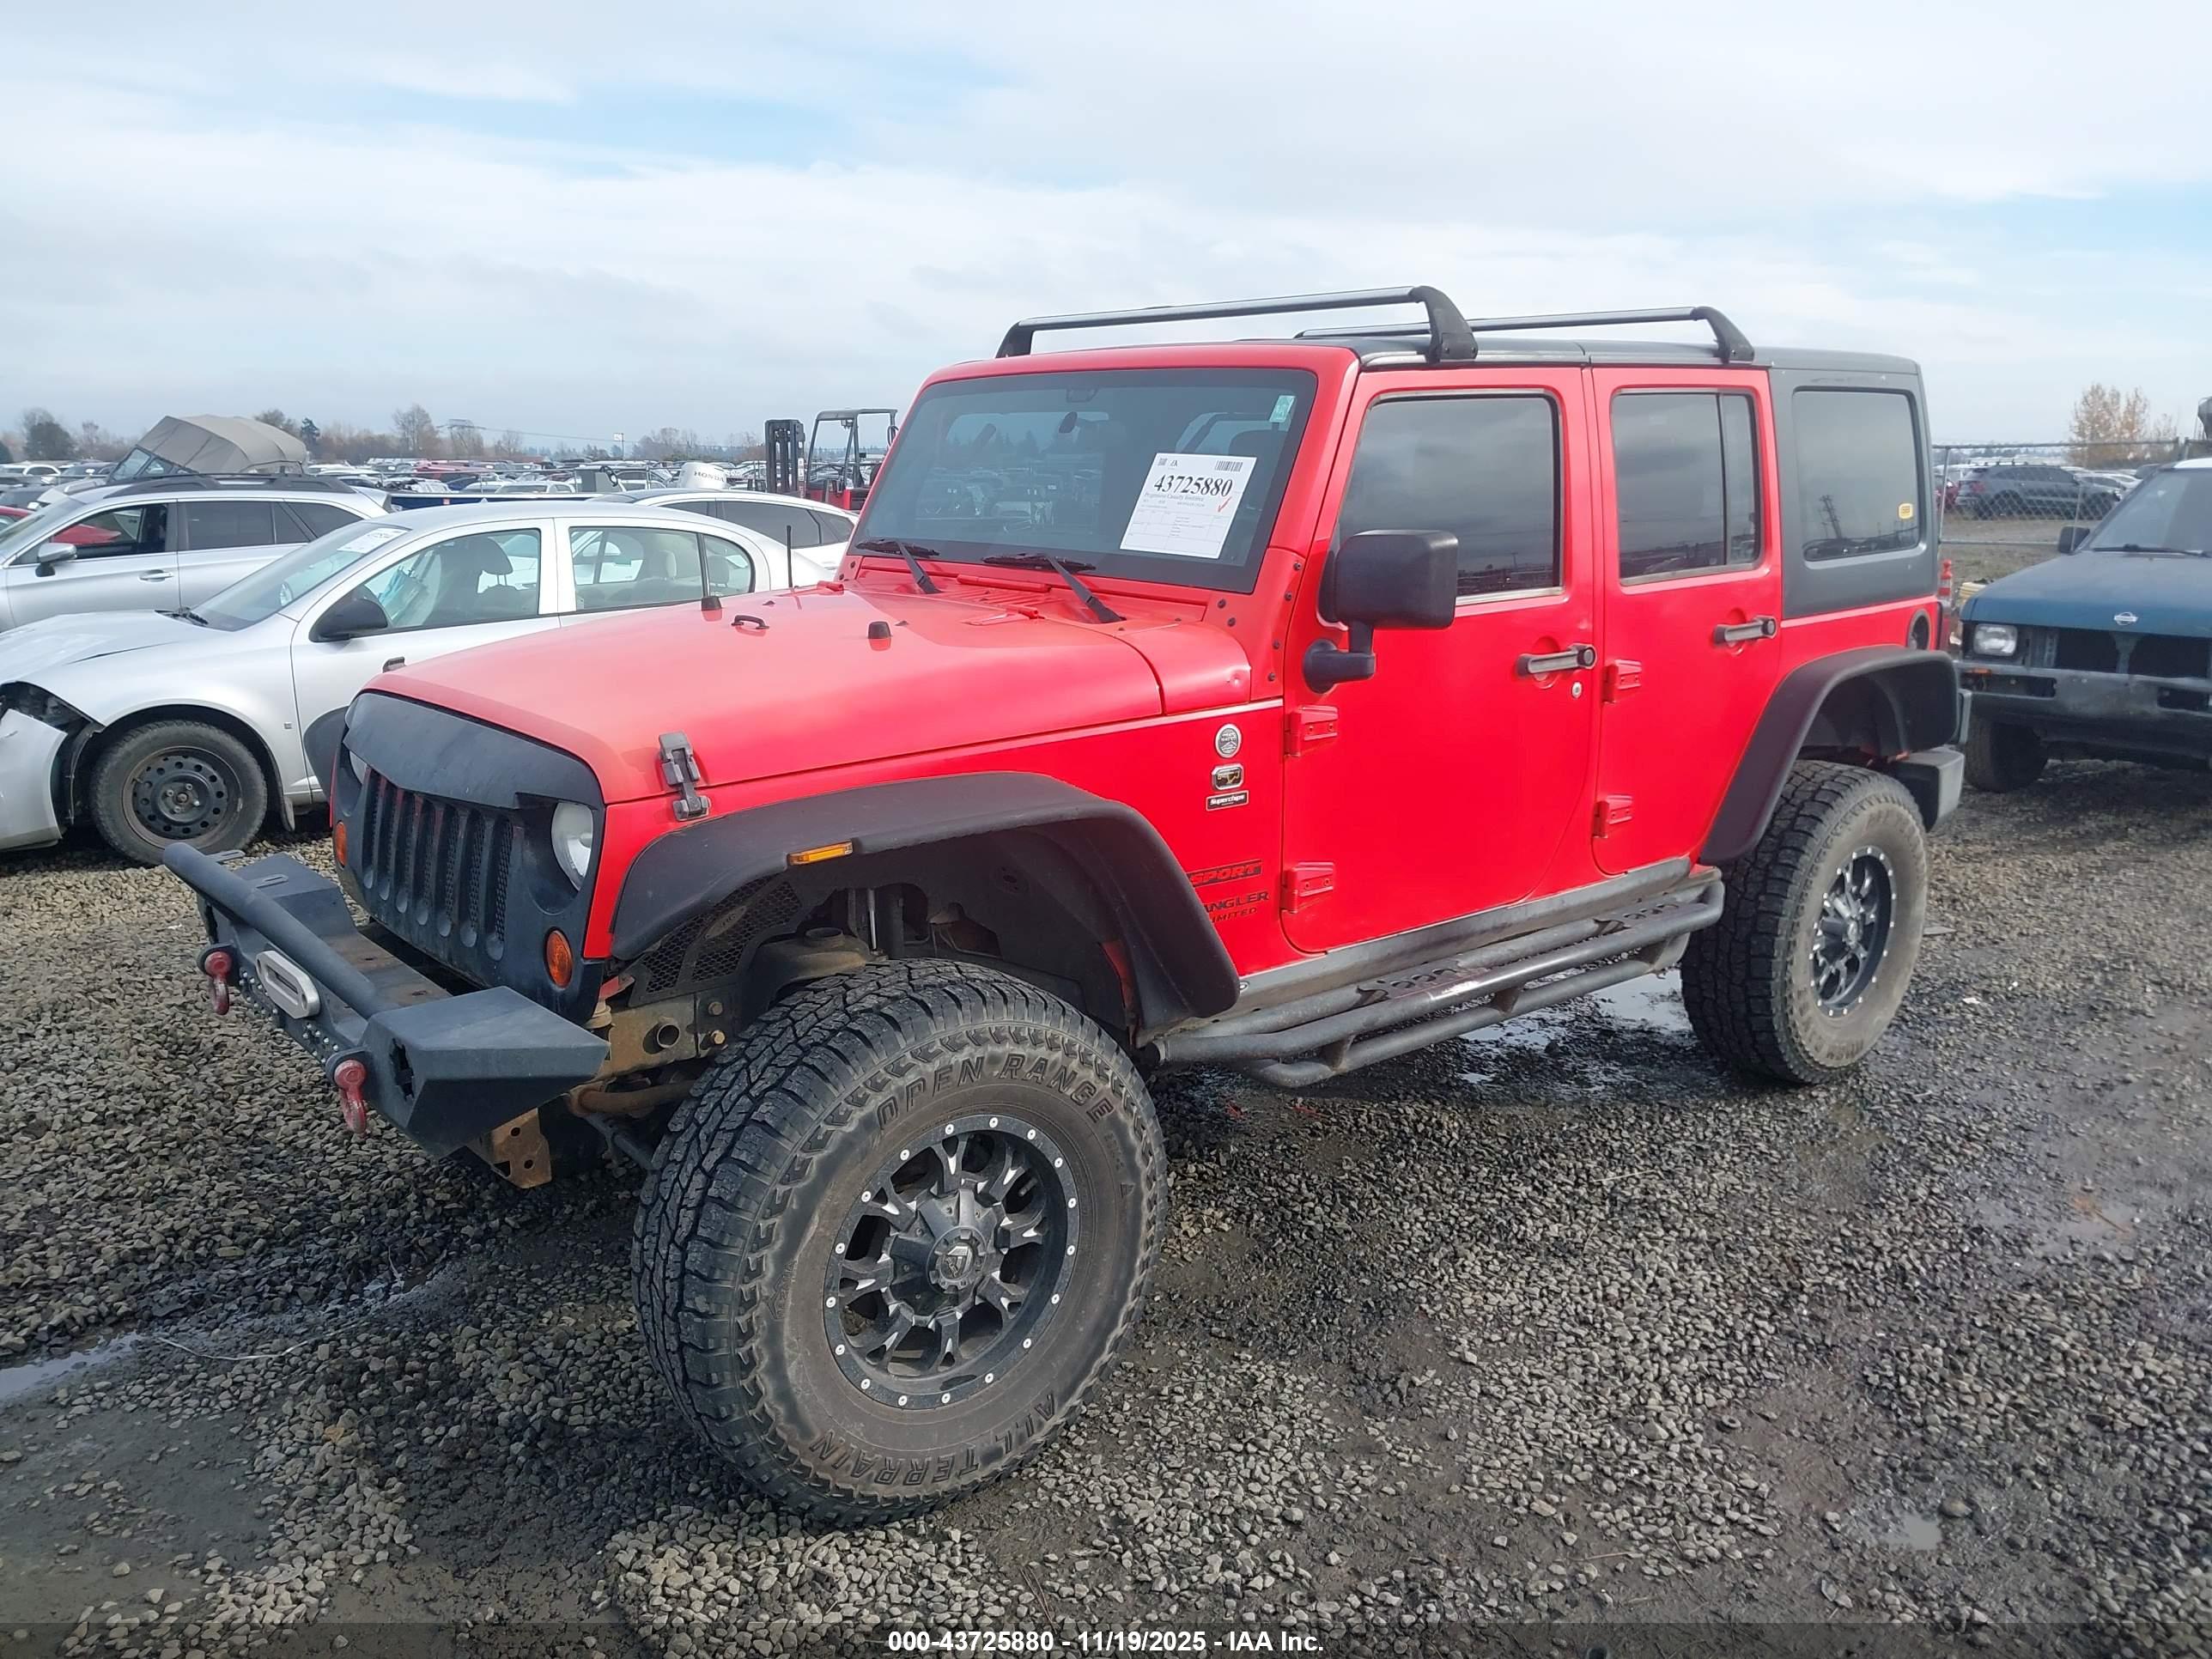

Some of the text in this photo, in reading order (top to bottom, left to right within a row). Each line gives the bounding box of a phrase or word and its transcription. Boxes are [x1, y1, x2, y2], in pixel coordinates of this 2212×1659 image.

[694, 471, 725, 483] HONDA
[1154, 474, 1233, 496] 43725880
[1189, 862, 1261, 885] SPORT
[1204, 891, 1269, 913] ANGLER
[1212, 907, 1257, 922] IMITED
[876, 1053, 1115, 1131] OPEN RANGE
[809, 1394, 1056, 1486] ALL TERRAIN
